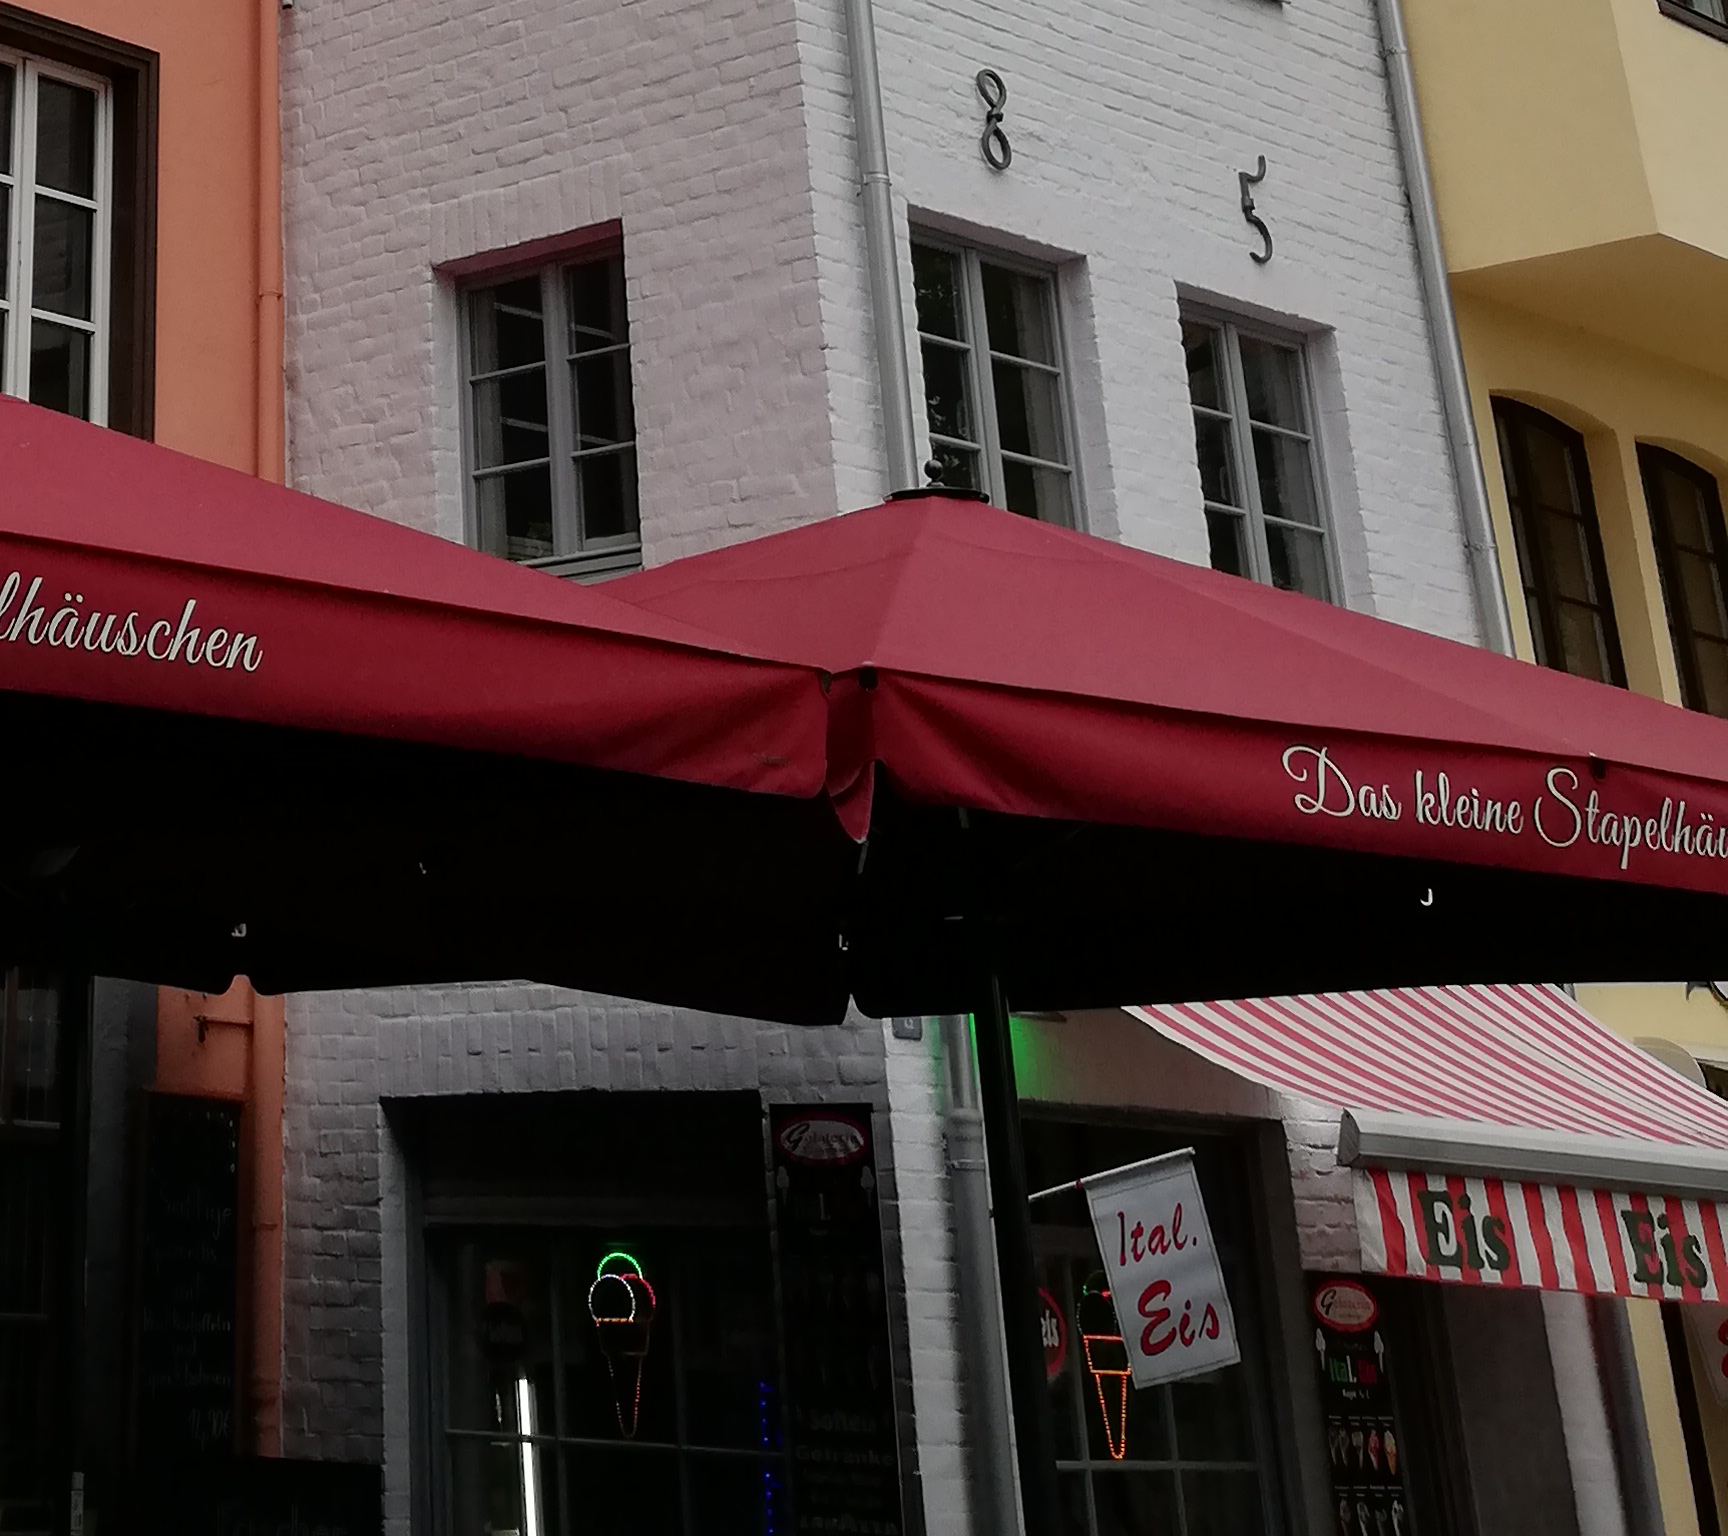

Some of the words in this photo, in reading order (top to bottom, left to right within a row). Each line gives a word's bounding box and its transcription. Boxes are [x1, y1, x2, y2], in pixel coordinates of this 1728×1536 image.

[975, 68, 1013, 172] 8
[1238, 154, 1273, 265] 5
[1281, 745, 1403, 821] Das
[1413, 769, 1524, 834] kleine
[1117, 1202, 1198, 1267] Ital.
[1417, 1190, 1511, 1272] Eis
[1621, 1209, 1708, 1288] Eis
[1137, 1279, 1220, 1357] Eis
